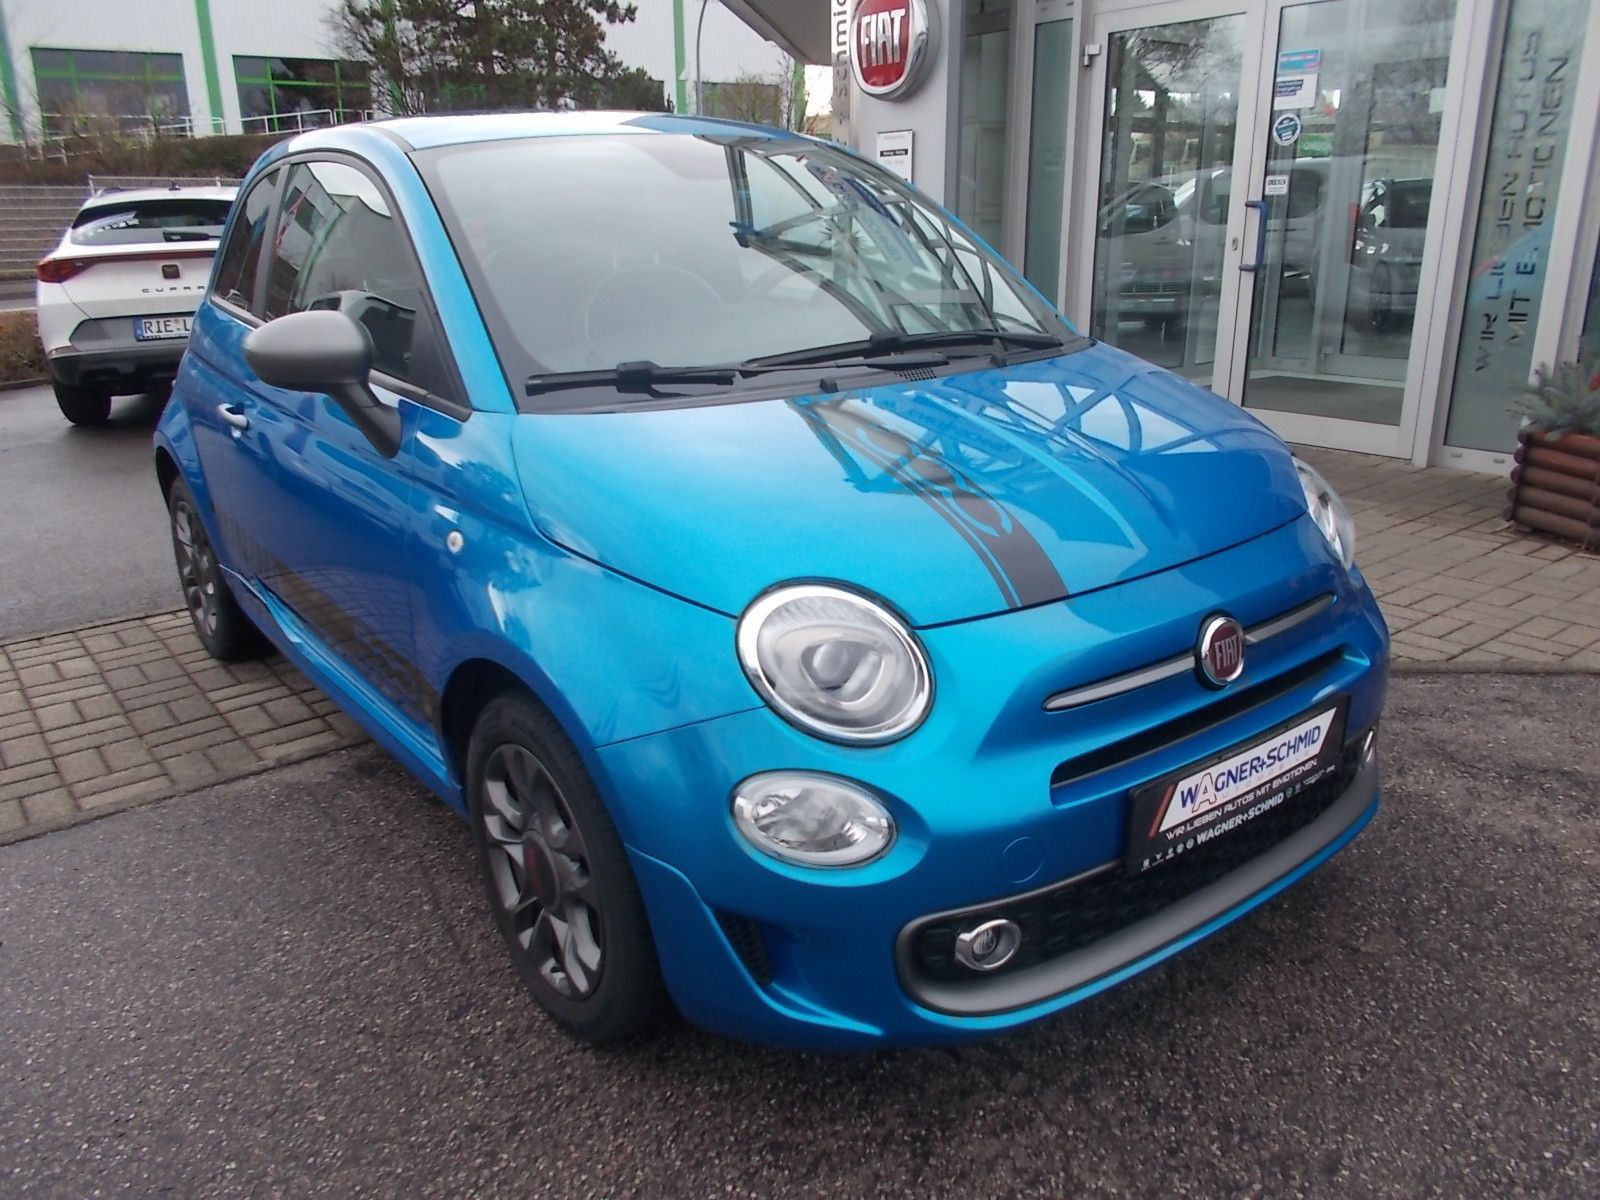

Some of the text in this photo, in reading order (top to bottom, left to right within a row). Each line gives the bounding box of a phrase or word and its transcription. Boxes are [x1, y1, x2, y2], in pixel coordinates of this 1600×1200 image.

[833, 0, 848, 99] Schmi
[860, 8, 906, 69] FIAT
[143, 319, 174, 334] RIE
[1214, 634, 1239, 671] FIAT
[1165, 826, 1185, 841] WIR
[1186, 809, 1223, 832] LIEBEN
[1223, 792, 1254, 812] AUTOS
[1255, 784, 1272, 798] MIT
[1272, 758, 1318, 790] EMOTIONEN
[1180, 725, 1322, 814] WAGNER+SCHMID
[1196, 791, 1285, 845] WAGNER+SCHMID
